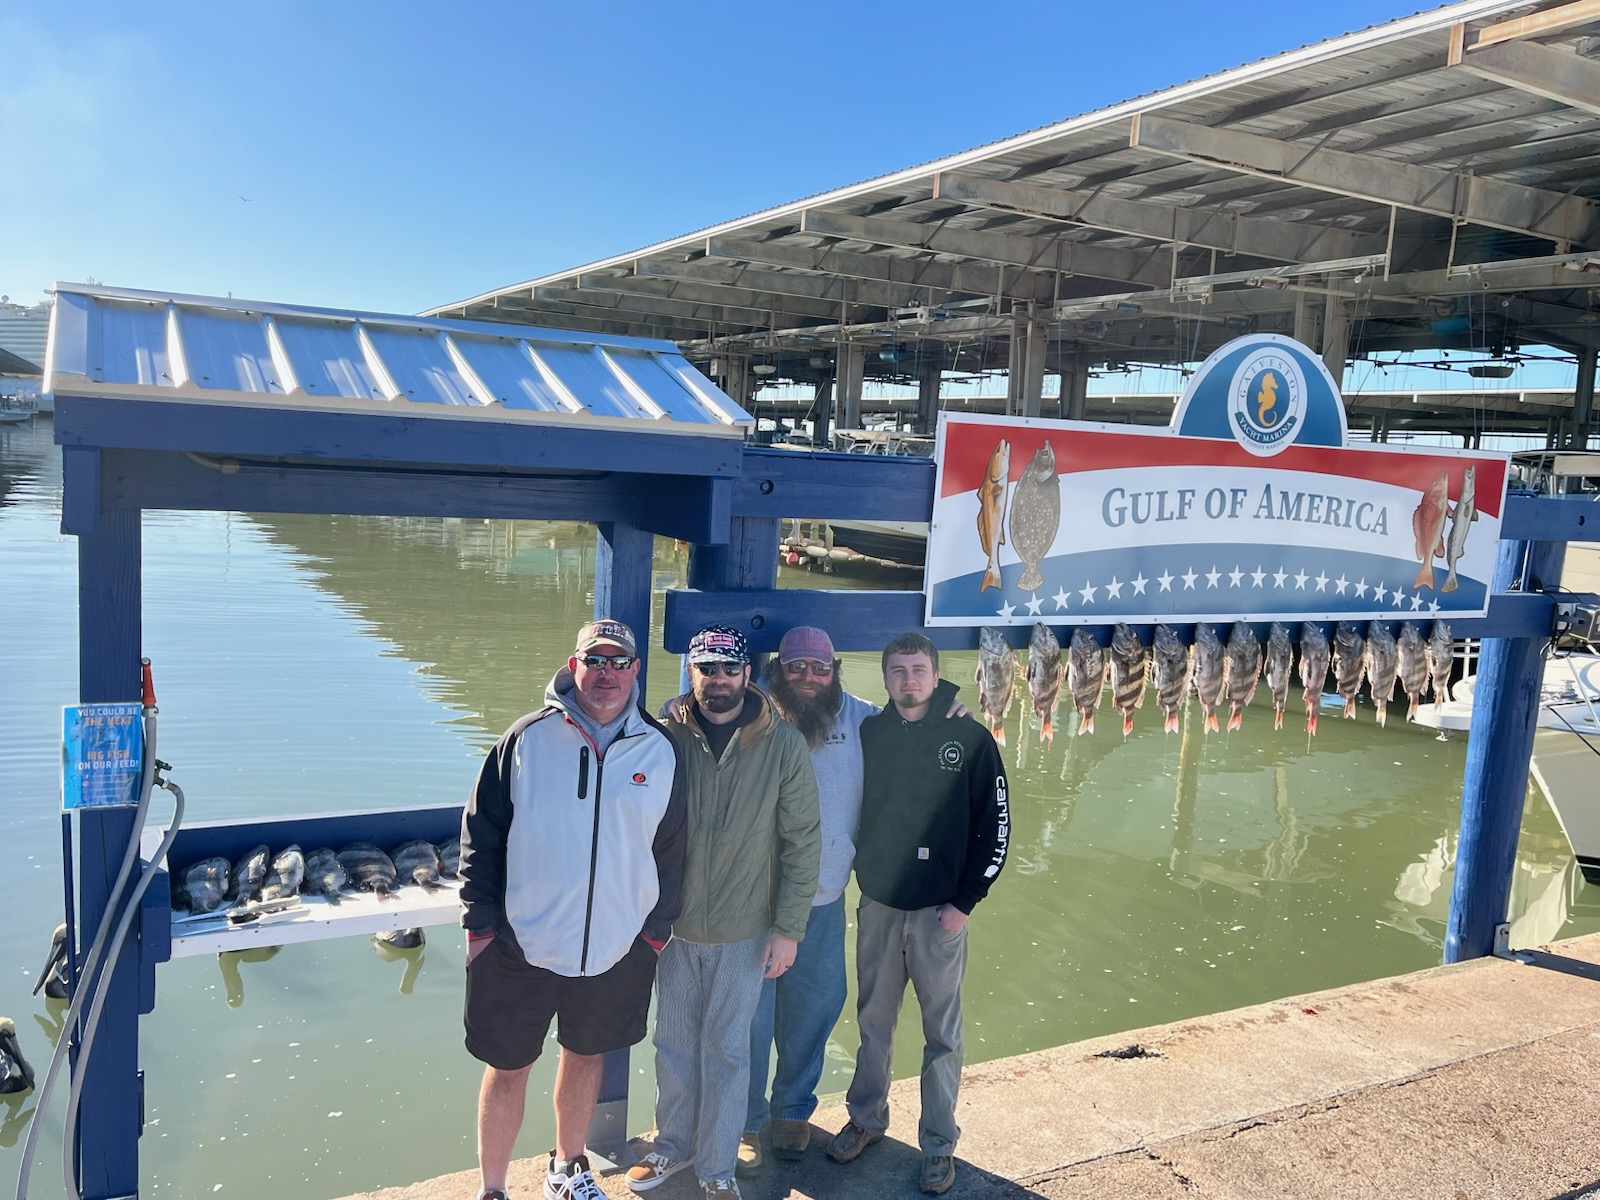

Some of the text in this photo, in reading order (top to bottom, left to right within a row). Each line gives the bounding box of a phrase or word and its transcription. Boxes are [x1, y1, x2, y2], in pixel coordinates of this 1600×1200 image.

[1240, 358, 1297, 403] GALVESTON
[1239, 417, 1293, 444] YACHT MARINA
[1266, 440, 1285, 450] MARINA
[1101, 483, 1389, 536] GULF OF AMERICA
[77, 707, 138, 717] YOU COULD BE
[85, 716, 132, 727] THE NEXT
[87, 750, 130, 760] BIG FISH
[78, 759, 139, 770] ON OUR FEED!
